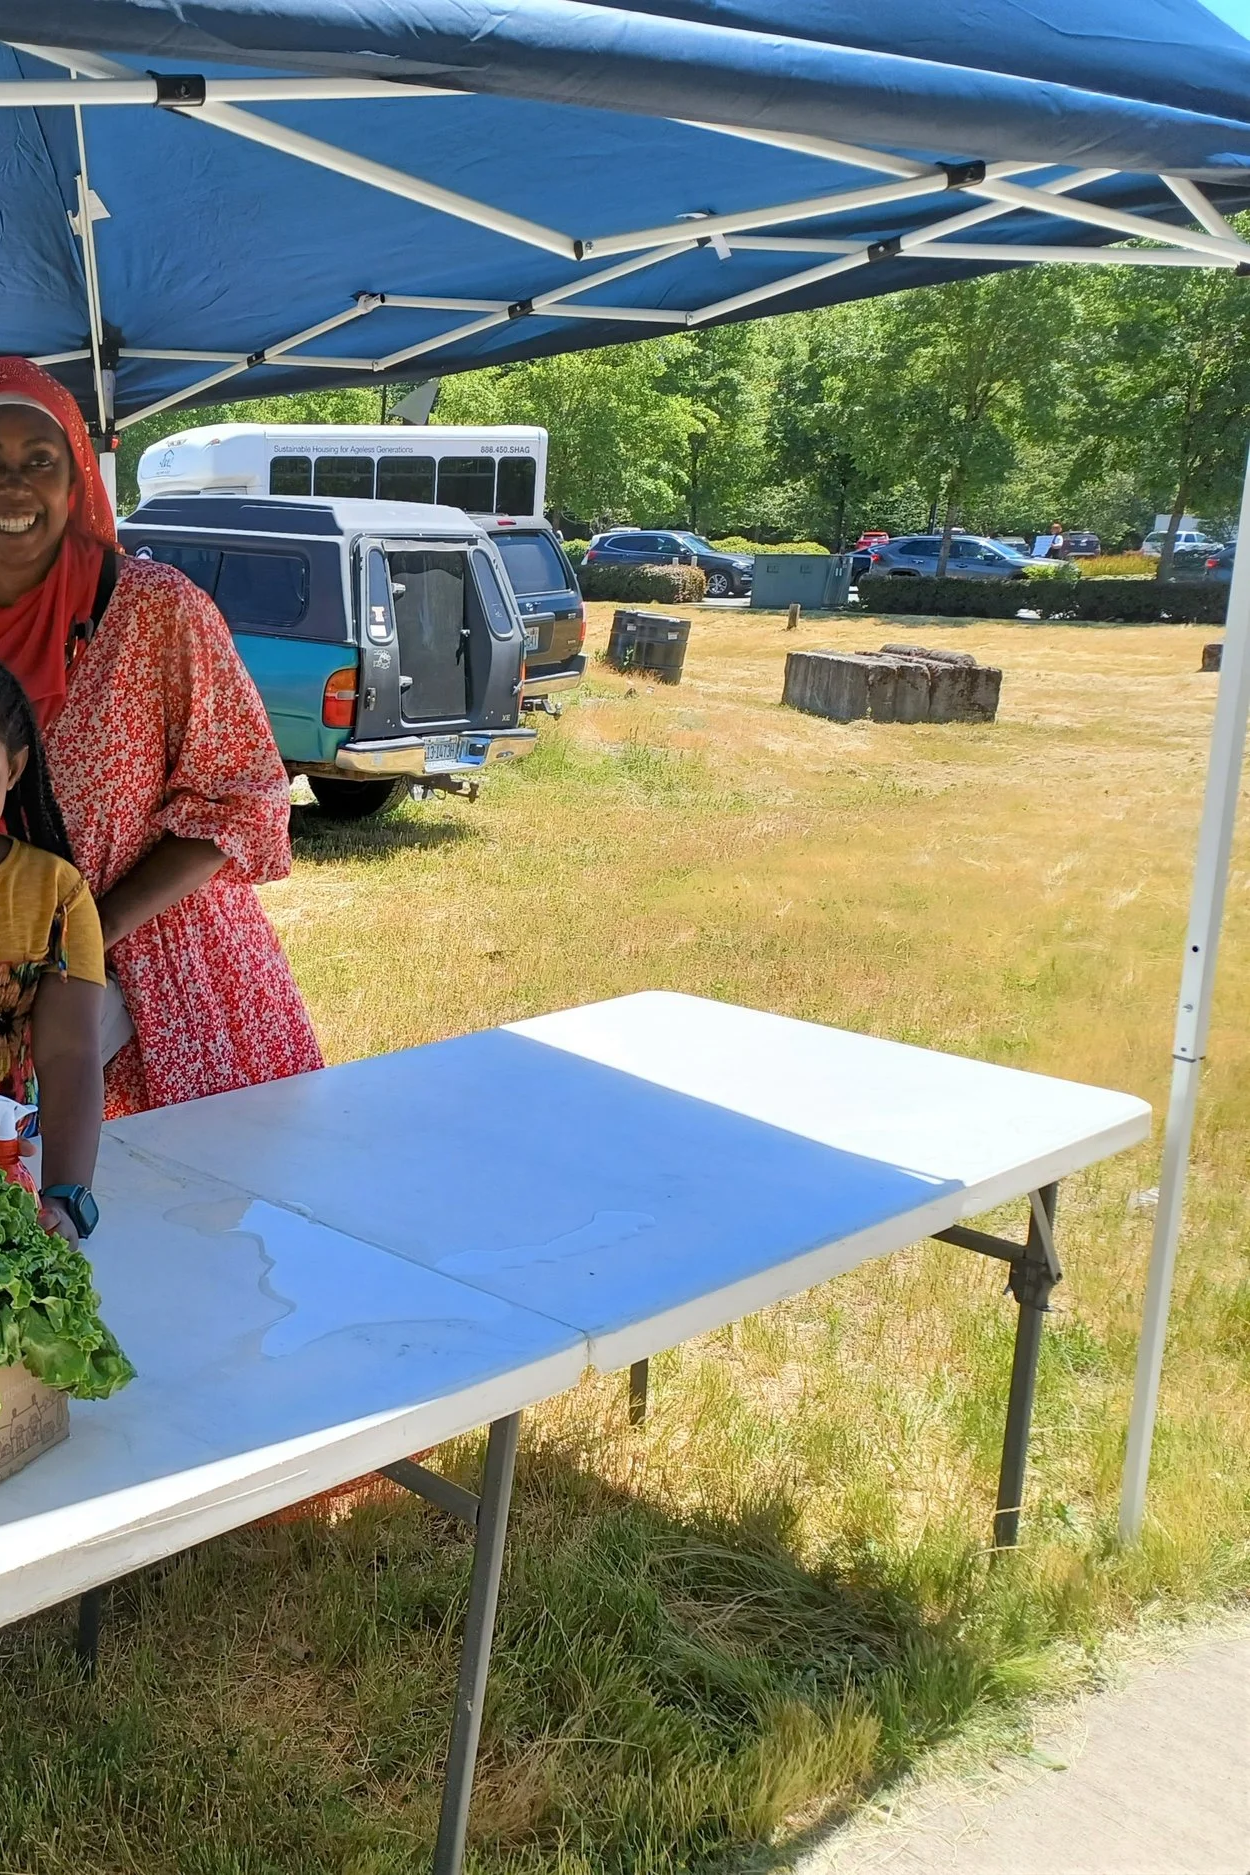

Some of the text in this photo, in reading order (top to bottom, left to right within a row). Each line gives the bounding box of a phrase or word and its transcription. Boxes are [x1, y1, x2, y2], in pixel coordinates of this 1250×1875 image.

[273, 445, 414, 455] Sustainable Housing for Ageless Generations
[480, 445, 530, 454] 888.450.SHAG
